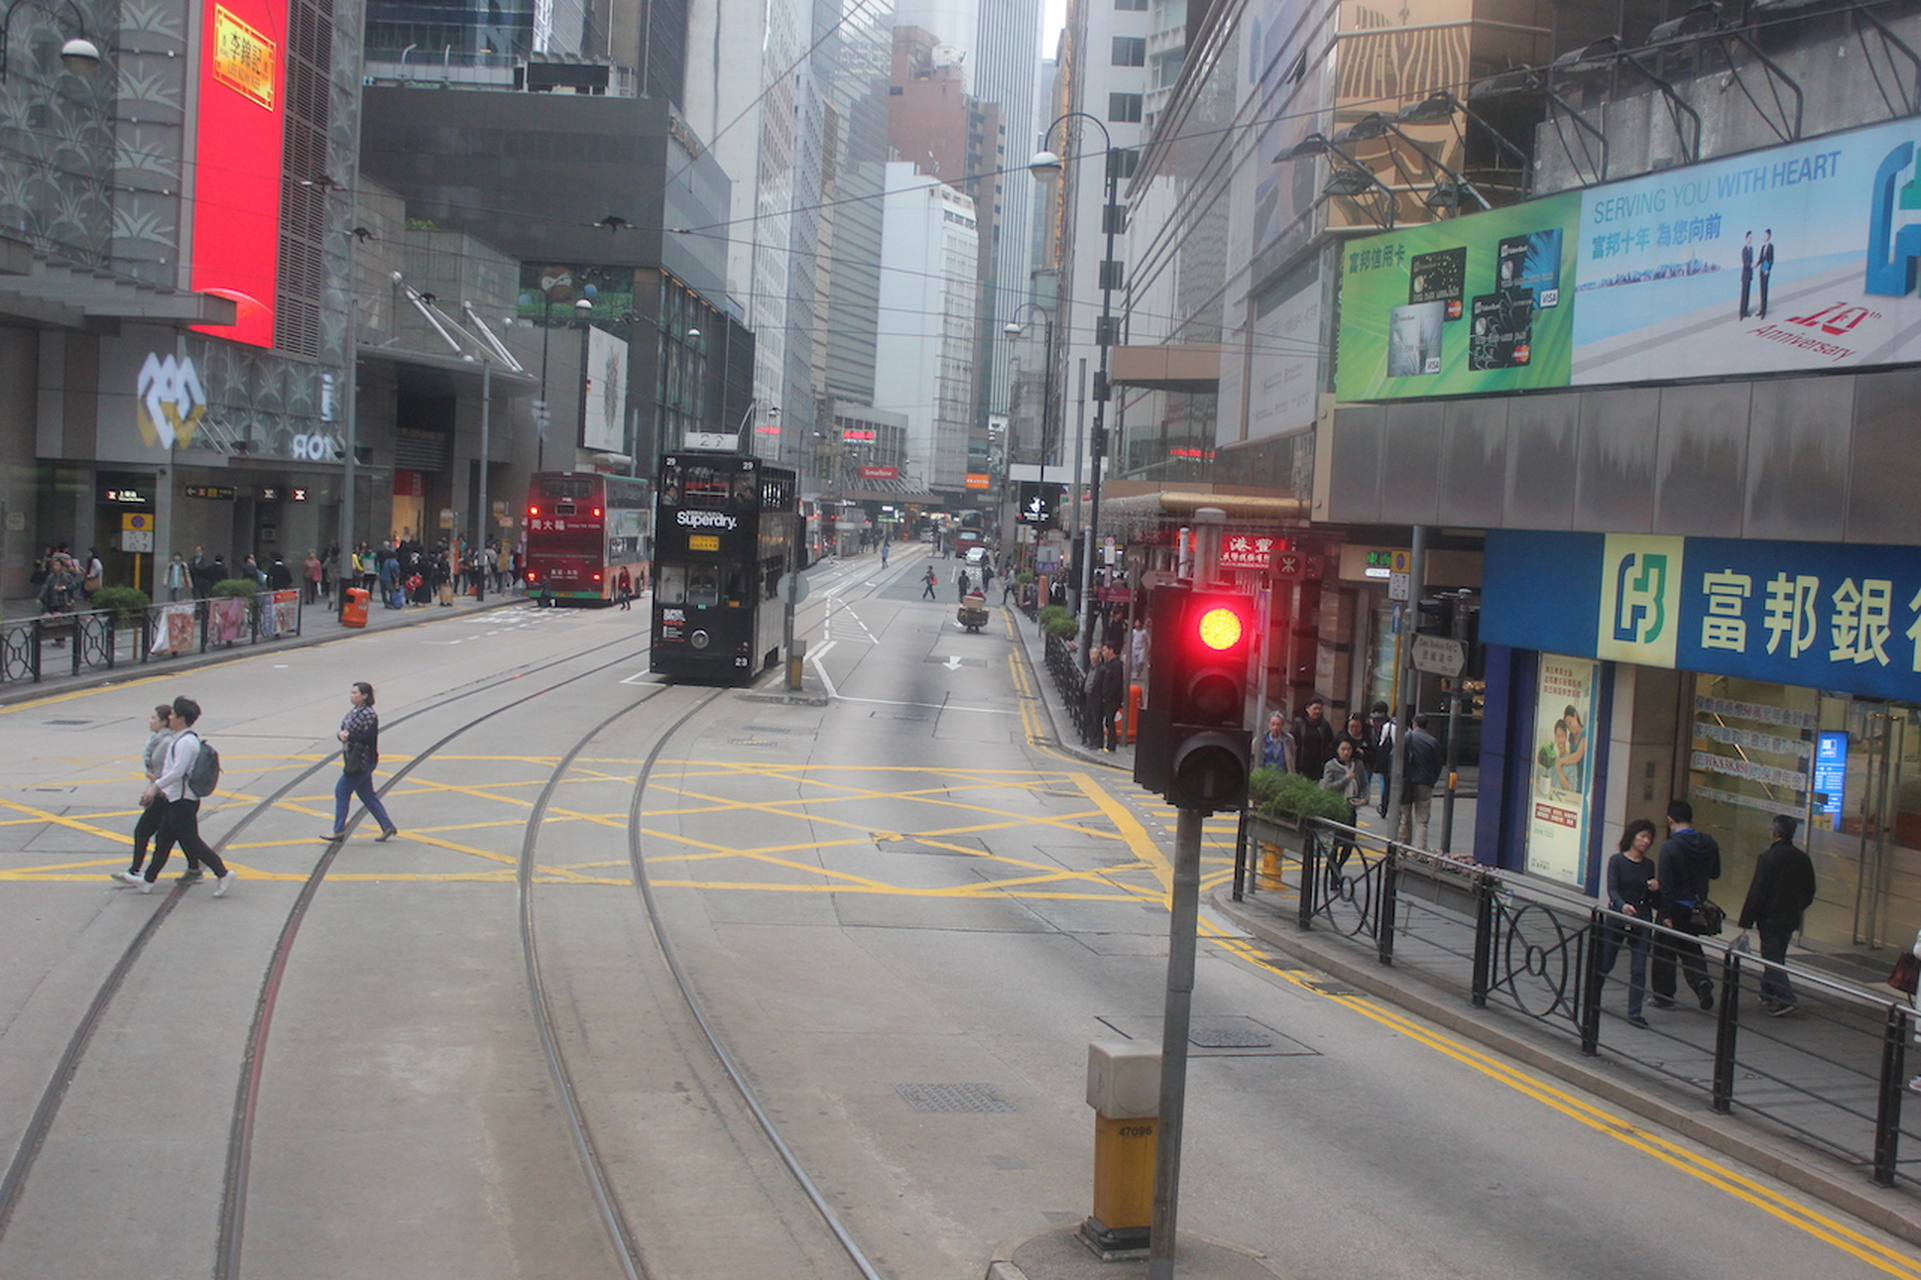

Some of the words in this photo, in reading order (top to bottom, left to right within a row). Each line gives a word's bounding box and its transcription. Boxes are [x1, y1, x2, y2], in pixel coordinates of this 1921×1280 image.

[1594, 188, 1667, 225] SERVING
[1672, 178, 1711, 208] YOU
[1717, 166, 1768, 200] WITH
[1772, 150, 1842, 188] HEART
[1592, 227, 1650, 260] 富邦十年
[1657, 212, 1722, 248] 為您向前
[1350, 243, 1406, 274] 富邦信用卡
[1543, 294, 1556, 304] VISA
[1747, 324, 1857, 361] Anniversary
[1427, 360, 1440, 371] VISA
[742, 461, 754, 471] 29
